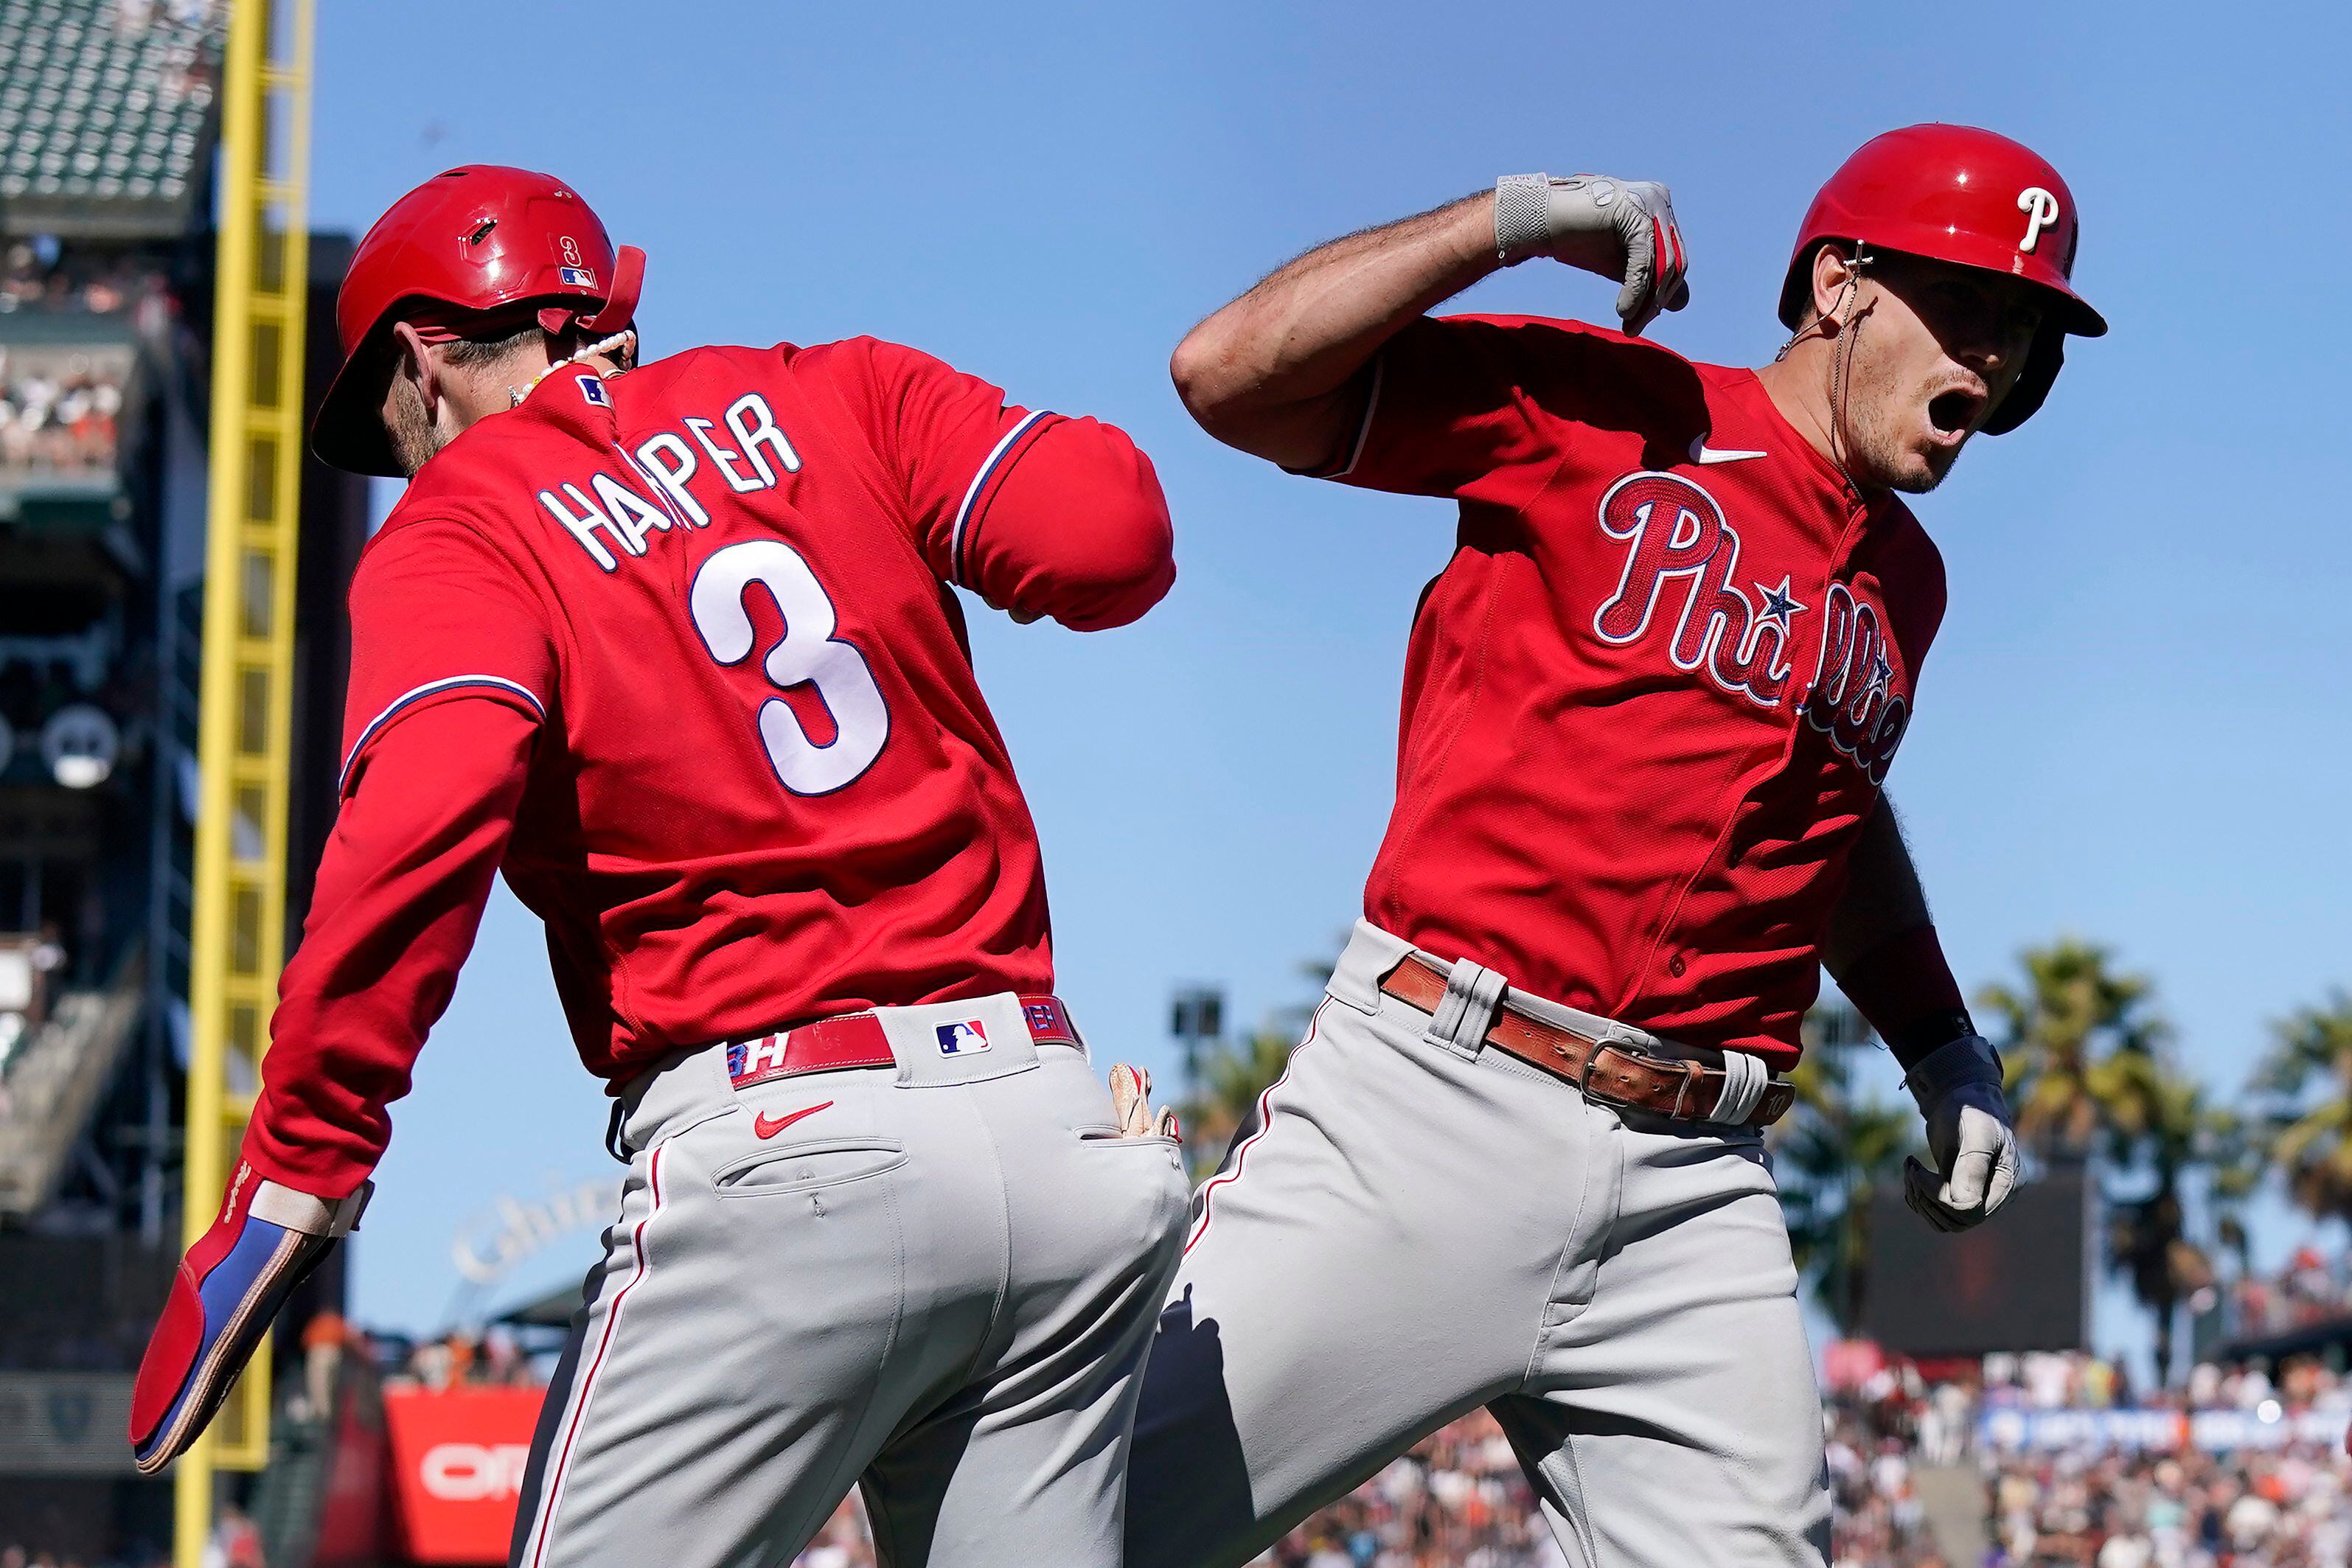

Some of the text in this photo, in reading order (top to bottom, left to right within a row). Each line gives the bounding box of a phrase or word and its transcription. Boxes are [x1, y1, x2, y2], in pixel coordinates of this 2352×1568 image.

[560, 236, 582, 267] 3
[2017, 187, 2059, 253] P
[1593, 470, 1910, 787] Phillie
[689, 538, 891, 797] 3
[1766, 1093, 1786, 1115] 10
